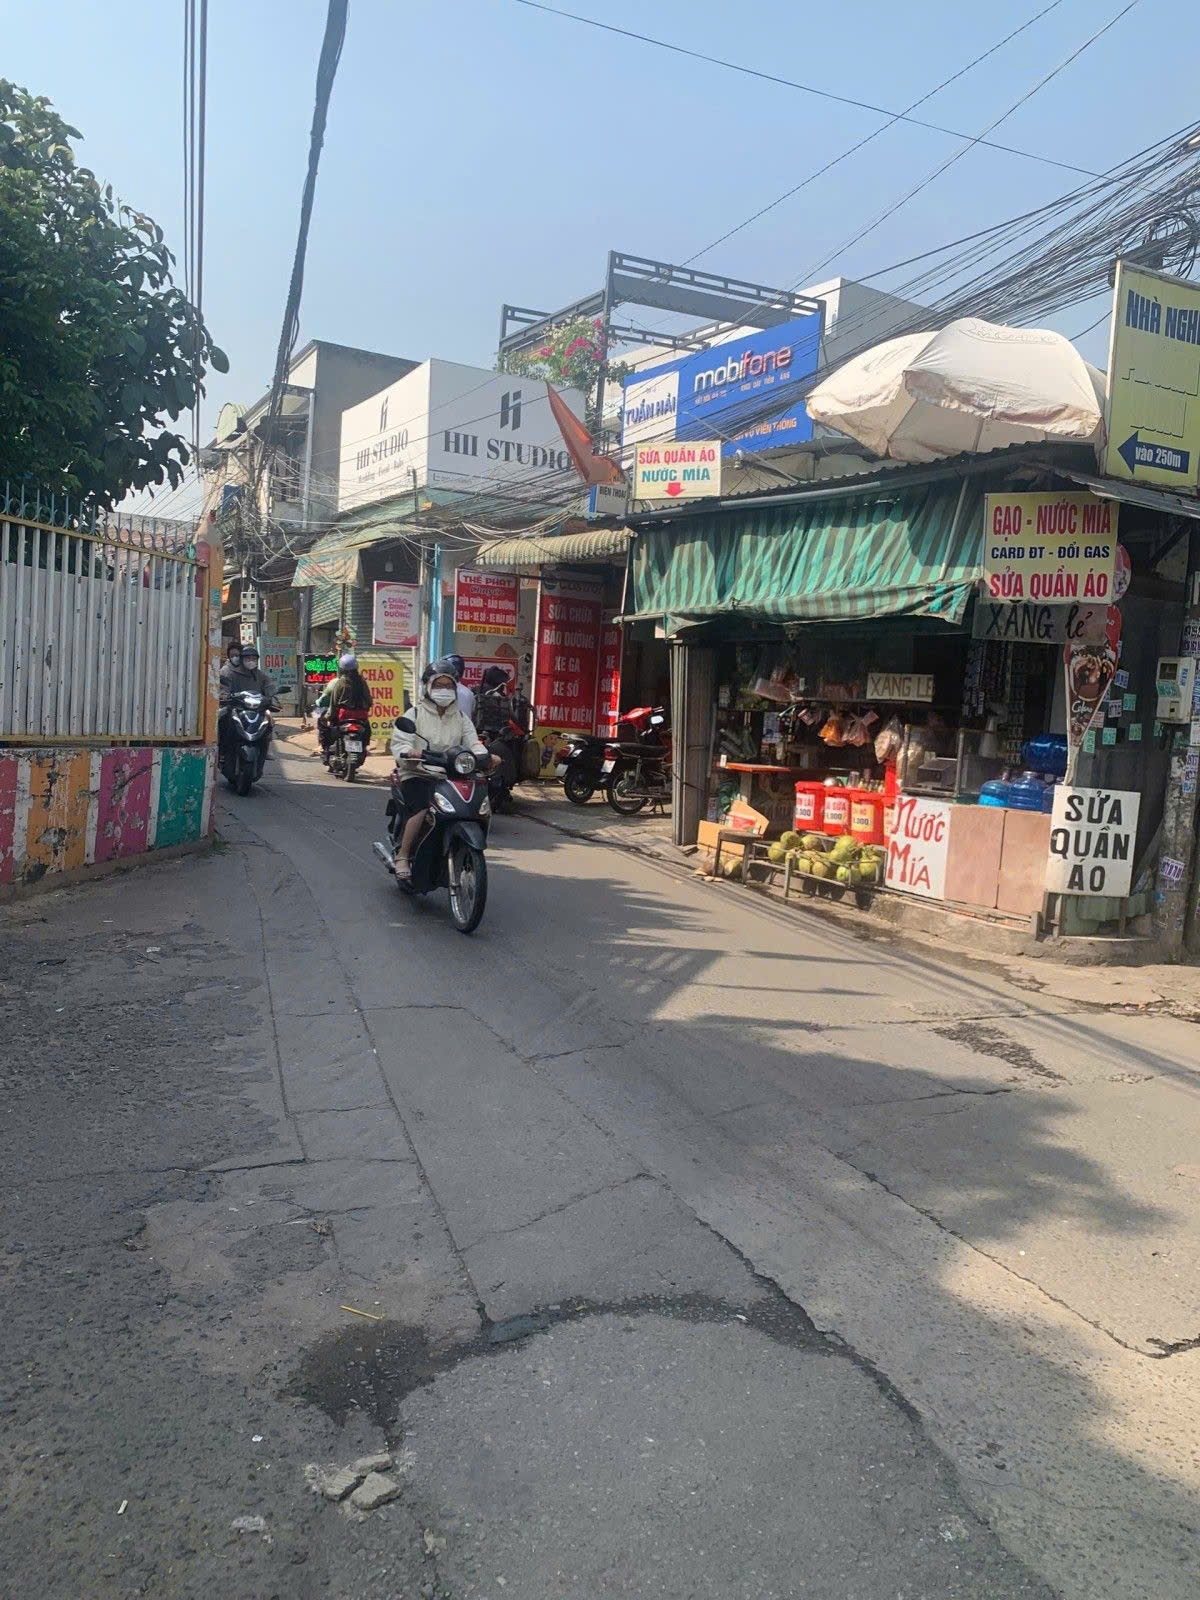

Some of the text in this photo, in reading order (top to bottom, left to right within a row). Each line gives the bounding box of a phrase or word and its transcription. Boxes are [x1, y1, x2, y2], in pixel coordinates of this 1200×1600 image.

[1126, 289, 1161, 334] NHÀ
[695, 346, 792, 392] mobifone
[373, 428, 408, 464] STUDIO
[444, 430, 572, 471] HII STUDIO
[1135, 444, 1181, 468] vào 250m
[993, 505, 1022, 542] GẠO
[1037, 498, 1078, 535] NƯỚC
[1082, 500, 1111, 534] MÍA
[991, 546, 1025, 559] CARD
[1029, 547, 1045, 559] ĐT
[1058, 541, 1080, 559] ĐỔI
[1084, 546, 1110, 559] GAS
[990, 565, 1108, 600] SỬA QUẦN ÁO
[548, 600, 566, 619] SỬA
[543, 626, 595, 649] BẢO DƯỠNG
[361, 665, 394, 682] CHÁO
[555, 656, 580, 672] XE GA
[369, 687, 393, 699] INH
[553, 679, 579, 697] XE SỐ
[536, 703, 593, 726] XE MÁY ĐIỆN
[1065, 790, 1122, 825] SỬA
[1050, 826, 1130, 860] QUẦN
[1067, 858, 1106, 892] ÁO
